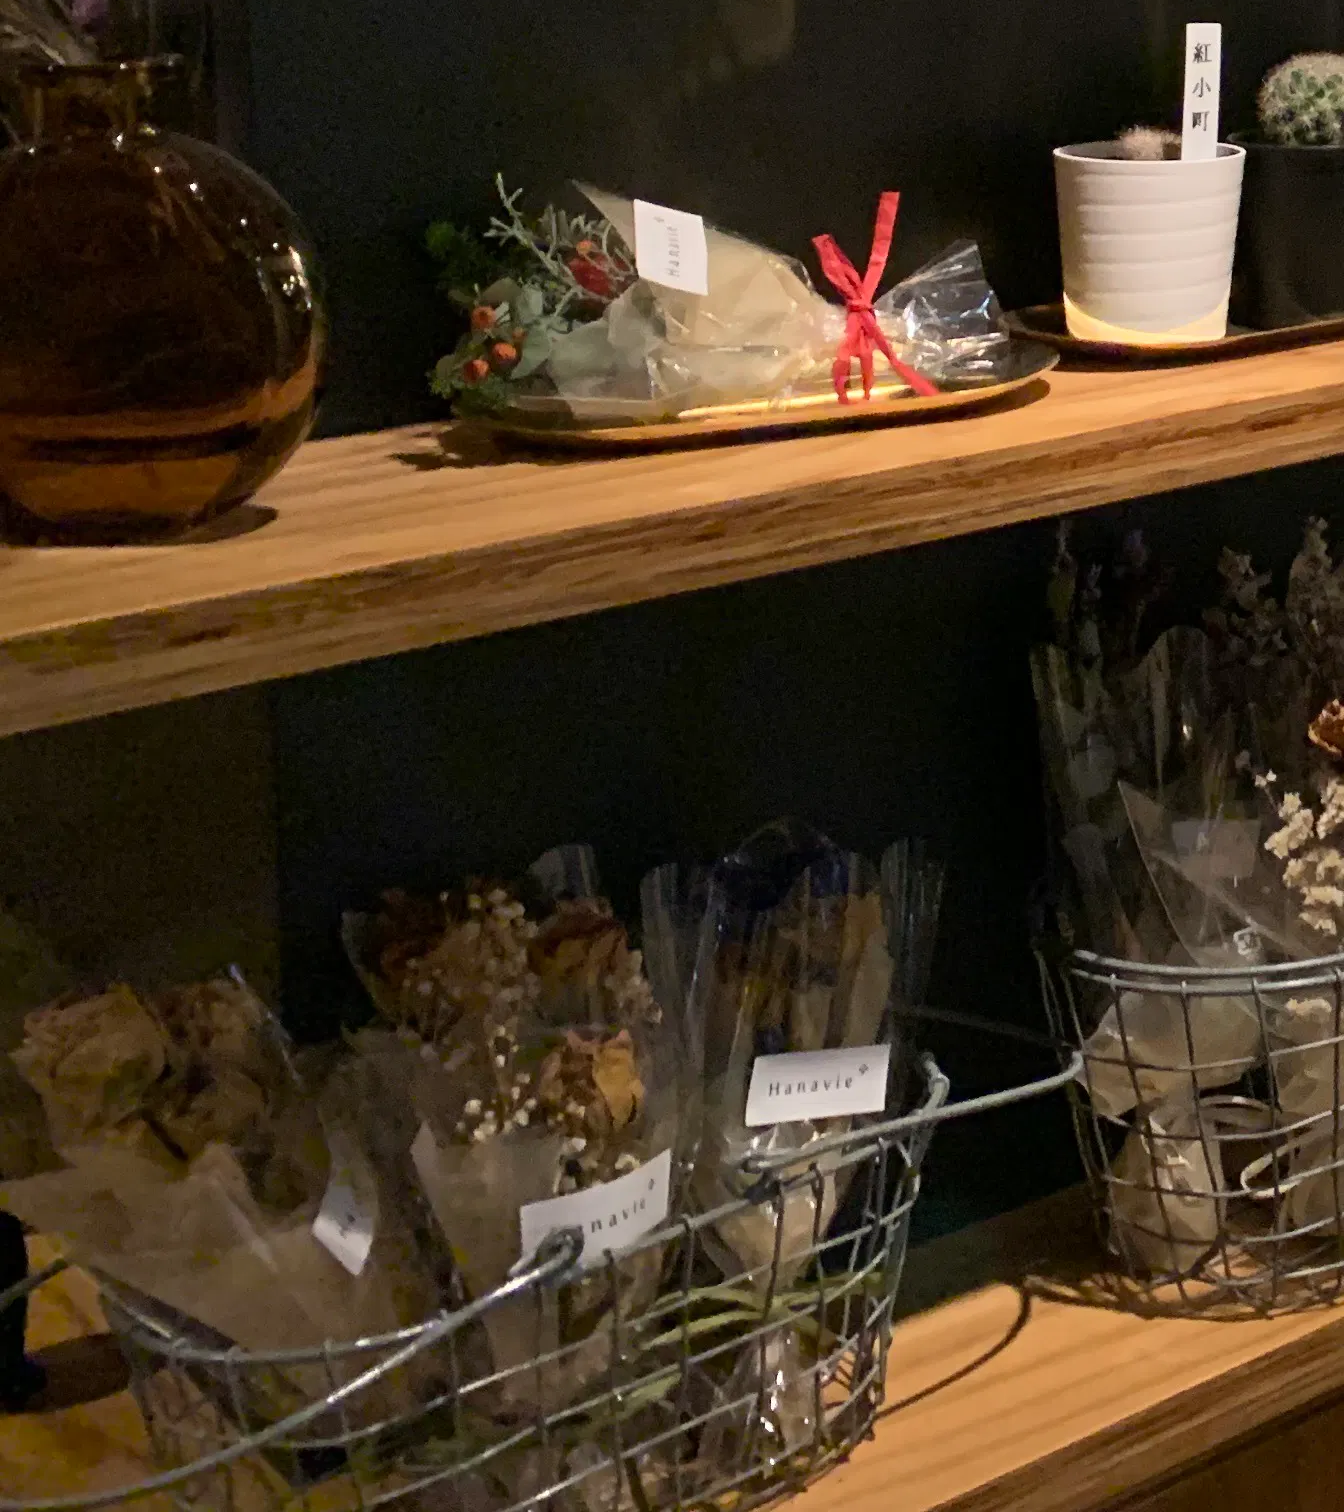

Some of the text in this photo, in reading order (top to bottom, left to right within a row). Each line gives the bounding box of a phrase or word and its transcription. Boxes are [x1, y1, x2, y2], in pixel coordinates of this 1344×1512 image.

[1191, 42, 1213, 133] 紅小町
[768, 1073, 854, 1097] Hanavie
